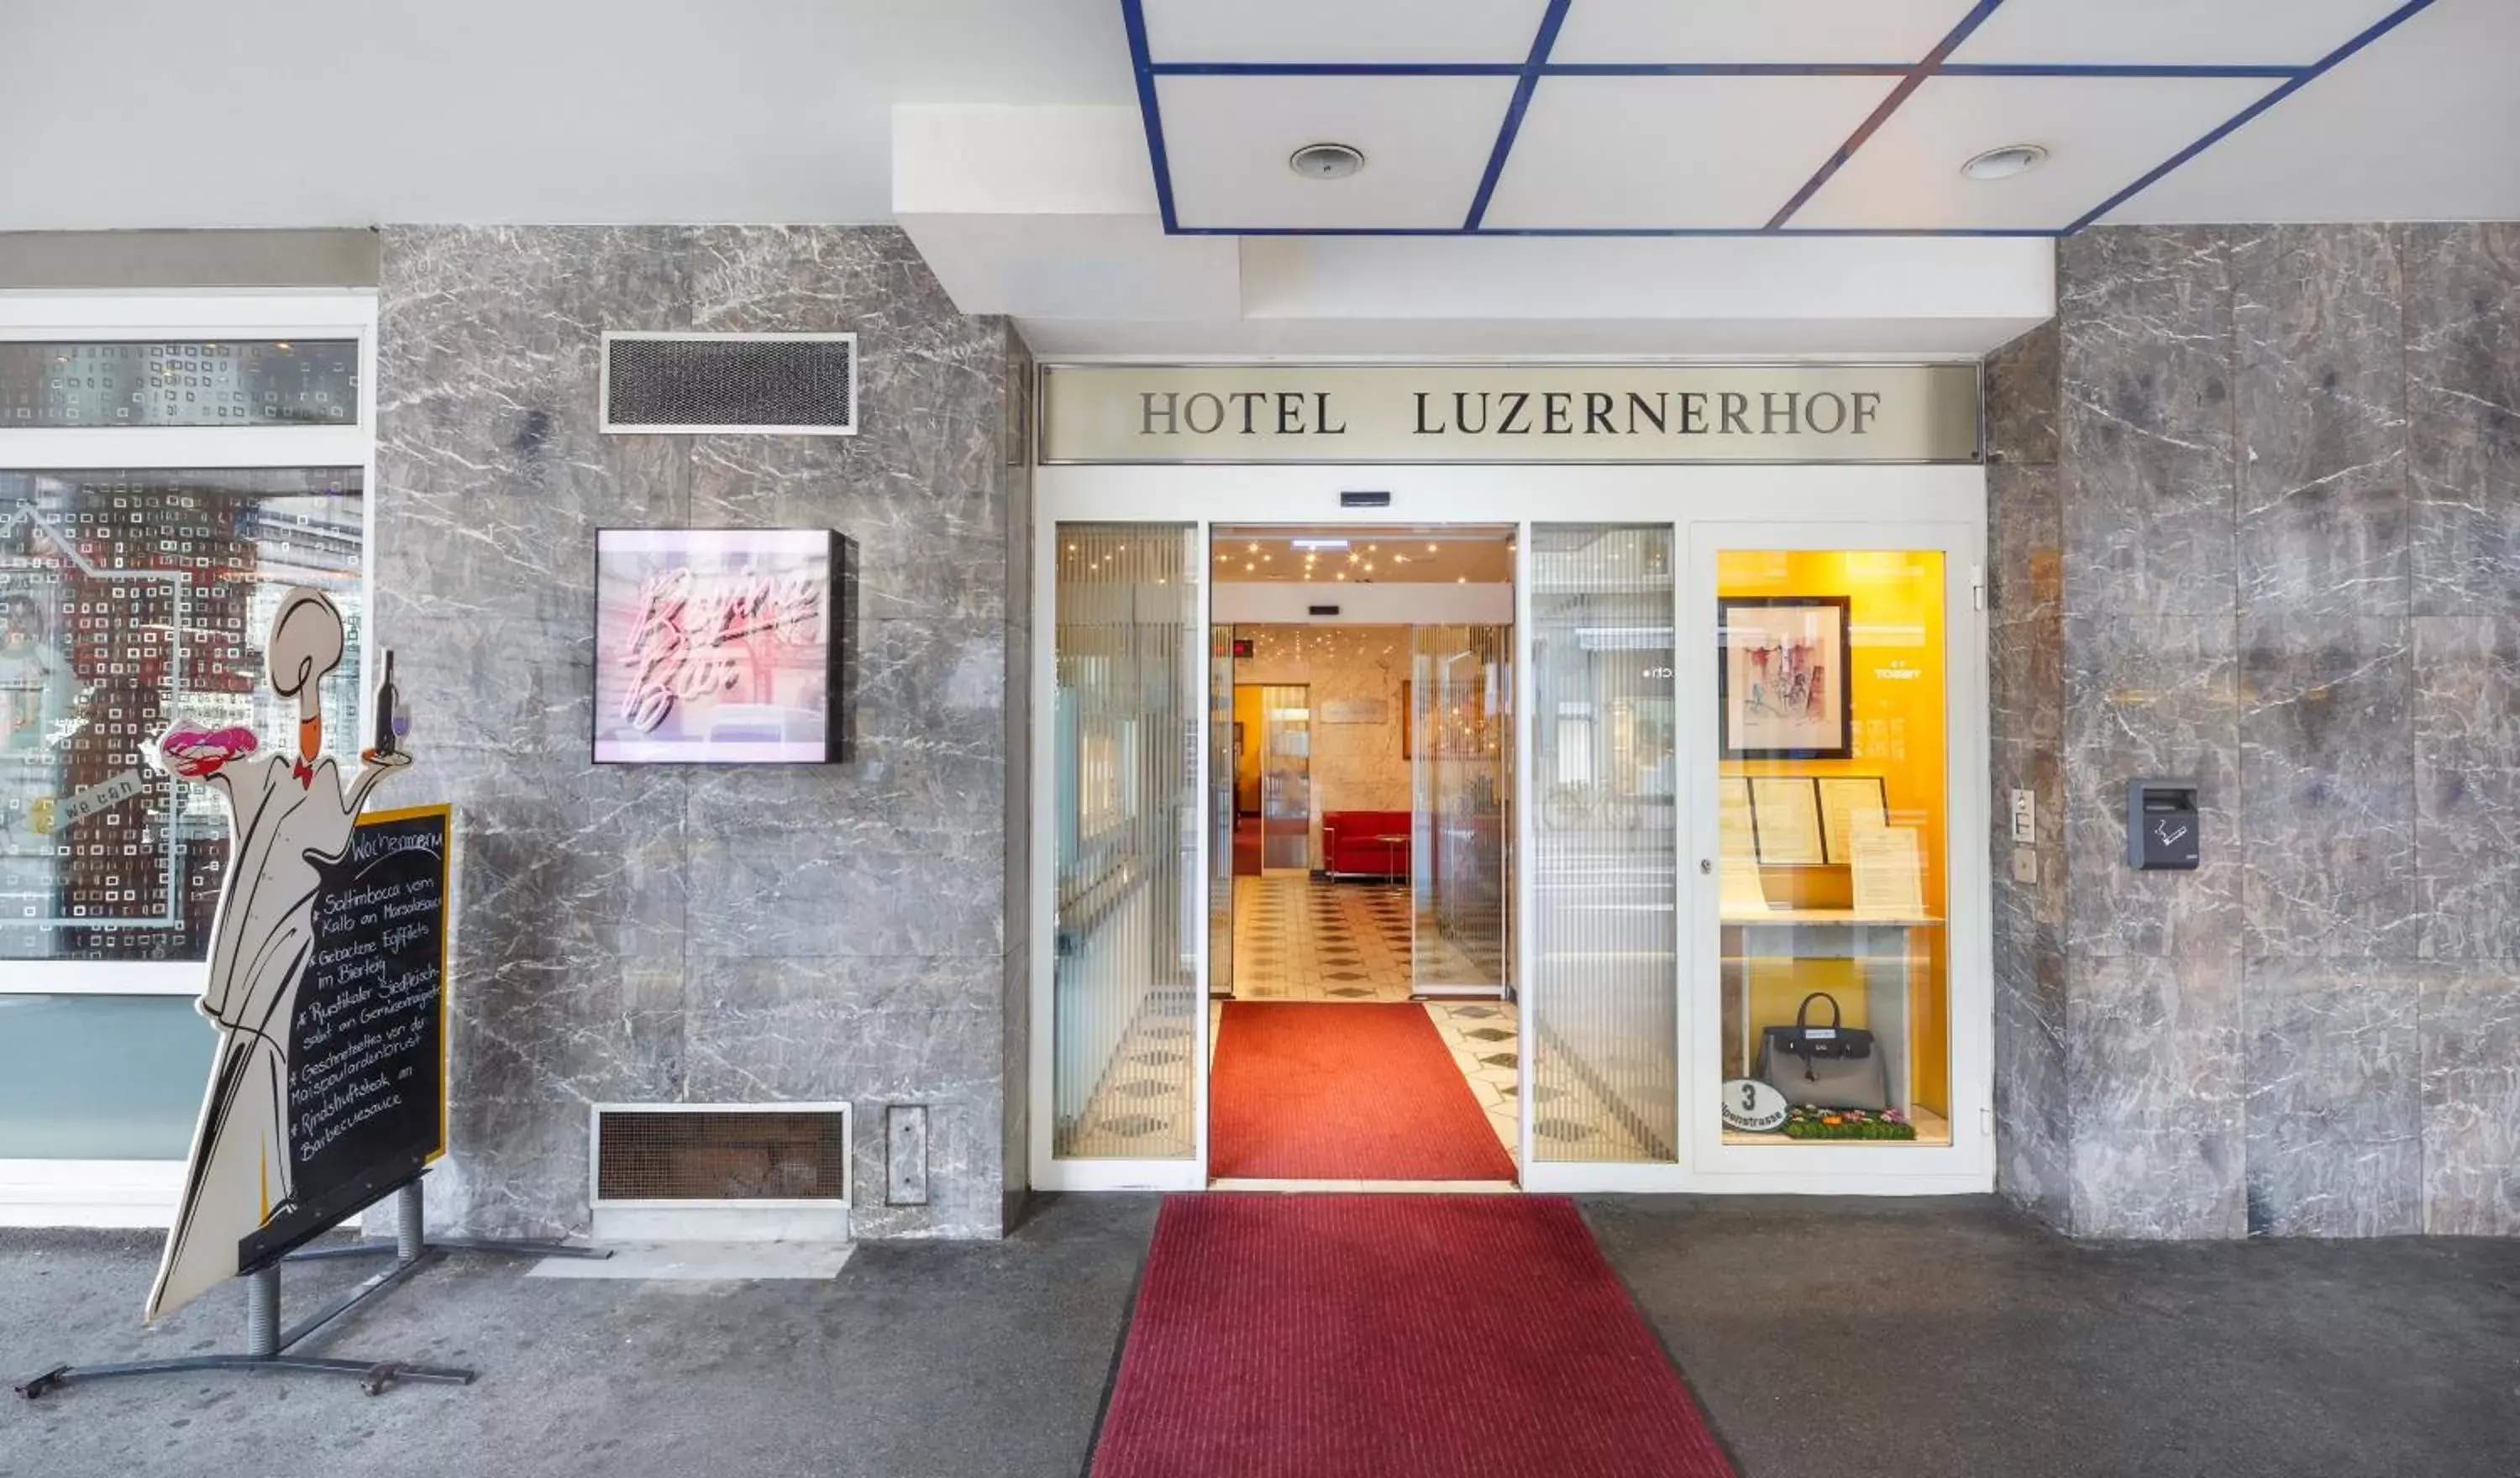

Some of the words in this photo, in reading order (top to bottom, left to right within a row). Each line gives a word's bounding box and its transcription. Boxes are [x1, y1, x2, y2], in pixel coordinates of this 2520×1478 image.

[1139, 392, 1347, 435] HOTEL
[1411, 391, 1881, 434] LUZERNERHOF
[322, 914, 355, 938] Kalb
[360, 913, 378, 925] an
[317, 972, 333, 990] im
[1741, 1083, 1756, 1111] 3
